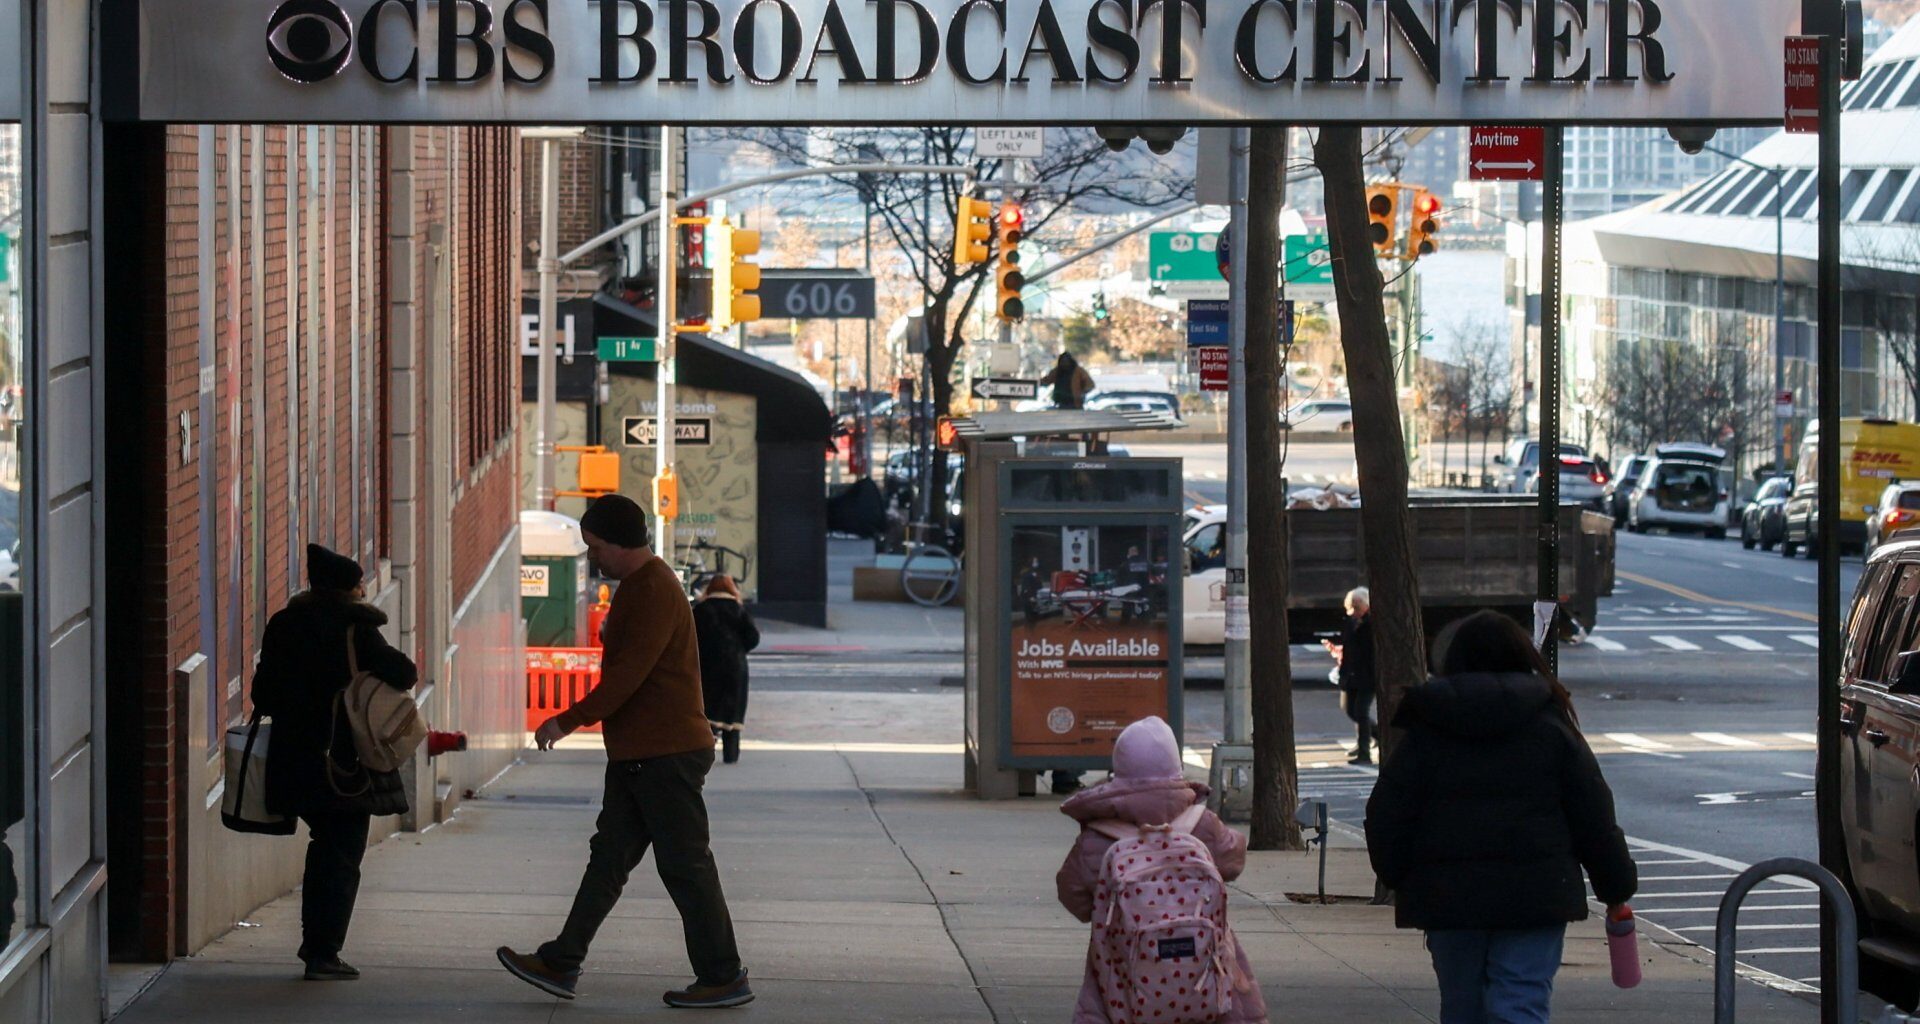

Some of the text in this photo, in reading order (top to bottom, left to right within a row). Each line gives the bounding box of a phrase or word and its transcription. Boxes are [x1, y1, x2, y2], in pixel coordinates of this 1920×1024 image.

[358, 0, 1677, 86] CBS BROADCAST CENTER
[1787, 48, 1797, 64] NO
[1788, 70, 1815, 91] Anytime
[981, 130, 1038, 140] LEFT LANE
[1474, 132, 1519, 149] Anytime
[996, 142, 1023, 152] ONLY
[785, 282, 857, 315] 606
[1191, 303, 1219, 311] Columbus
[1191, 325, 1219, 333] East Side
[615, 341, 641, 358] 11 Av
[1202, 352, 1211, 360] NO
[1203, 362, 1228, 372] Anytime
[980, 384, 1030, 395] ONE WAY
[1853, 452, 1902, 464] DHL
[1018, 638, 1160, 656] Jobs Available
[1018, 660, 1065, 669] With NYC
[1072, 672, 1092, 681] hiring
[1094, 672, 1137, 681] professional
[1139, 672, 1162, 681] today!
